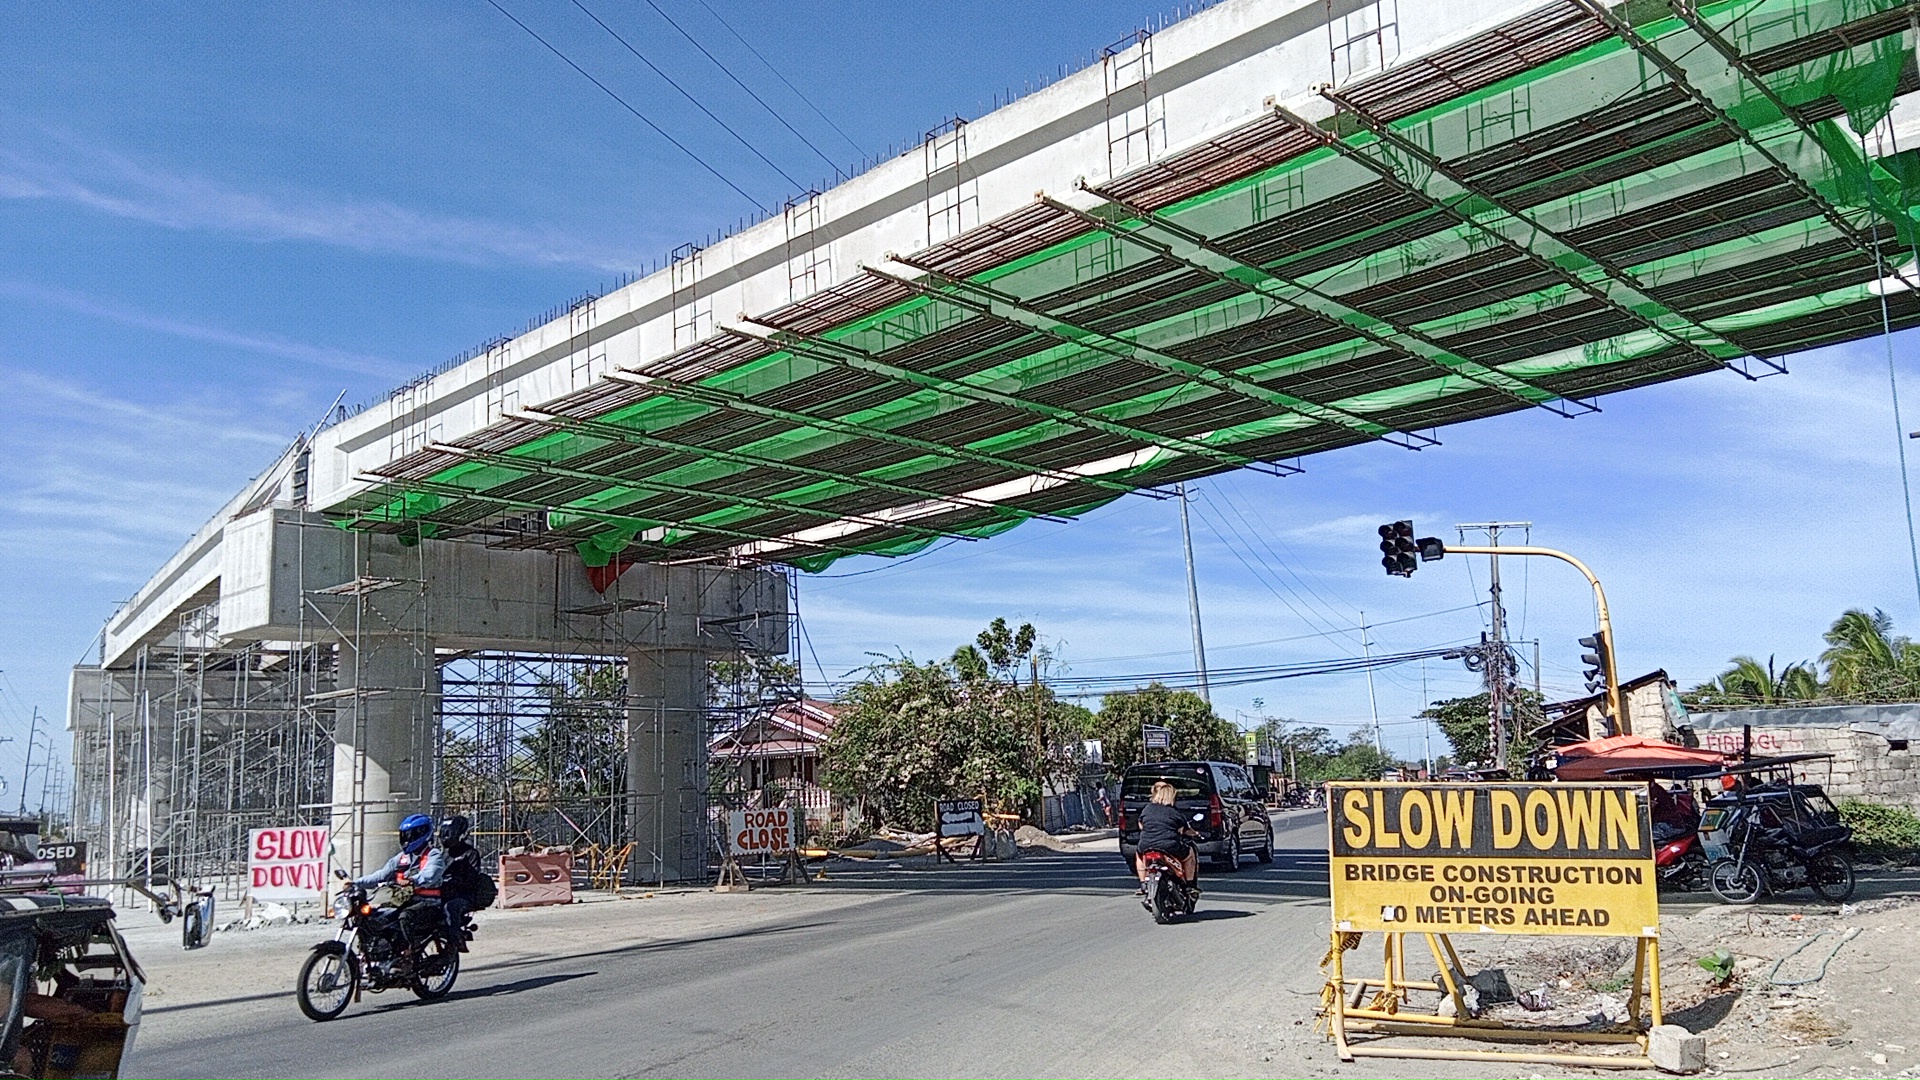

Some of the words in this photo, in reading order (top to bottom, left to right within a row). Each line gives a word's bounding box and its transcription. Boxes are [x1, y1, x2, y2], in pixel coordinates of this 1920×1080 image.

[939, 802, 955, 812] ROAD
[957, 800, 980, 811] CLOSED
[745, 811, 788, 829] ROAD
[1343, 789, 1474, 849] SLOW
[1491, 789, 1640, 850] DOWN
[255, 830, 326, 860] SLOW
[737, 828, 789, 851] CLOSE
[37, 846, 76, 860] OSED
[252, 862, 324, 891] DOWN
[1345, 863, 1434, 882] BRIDGE
[1443, 865, 1642, 884] CONSTRUCTION
[1430, 885, 1554, 904] ON-GOING
[1416, 906, 1515, 925] METERS
[1524, 907, 1610, 927] AHEAD
